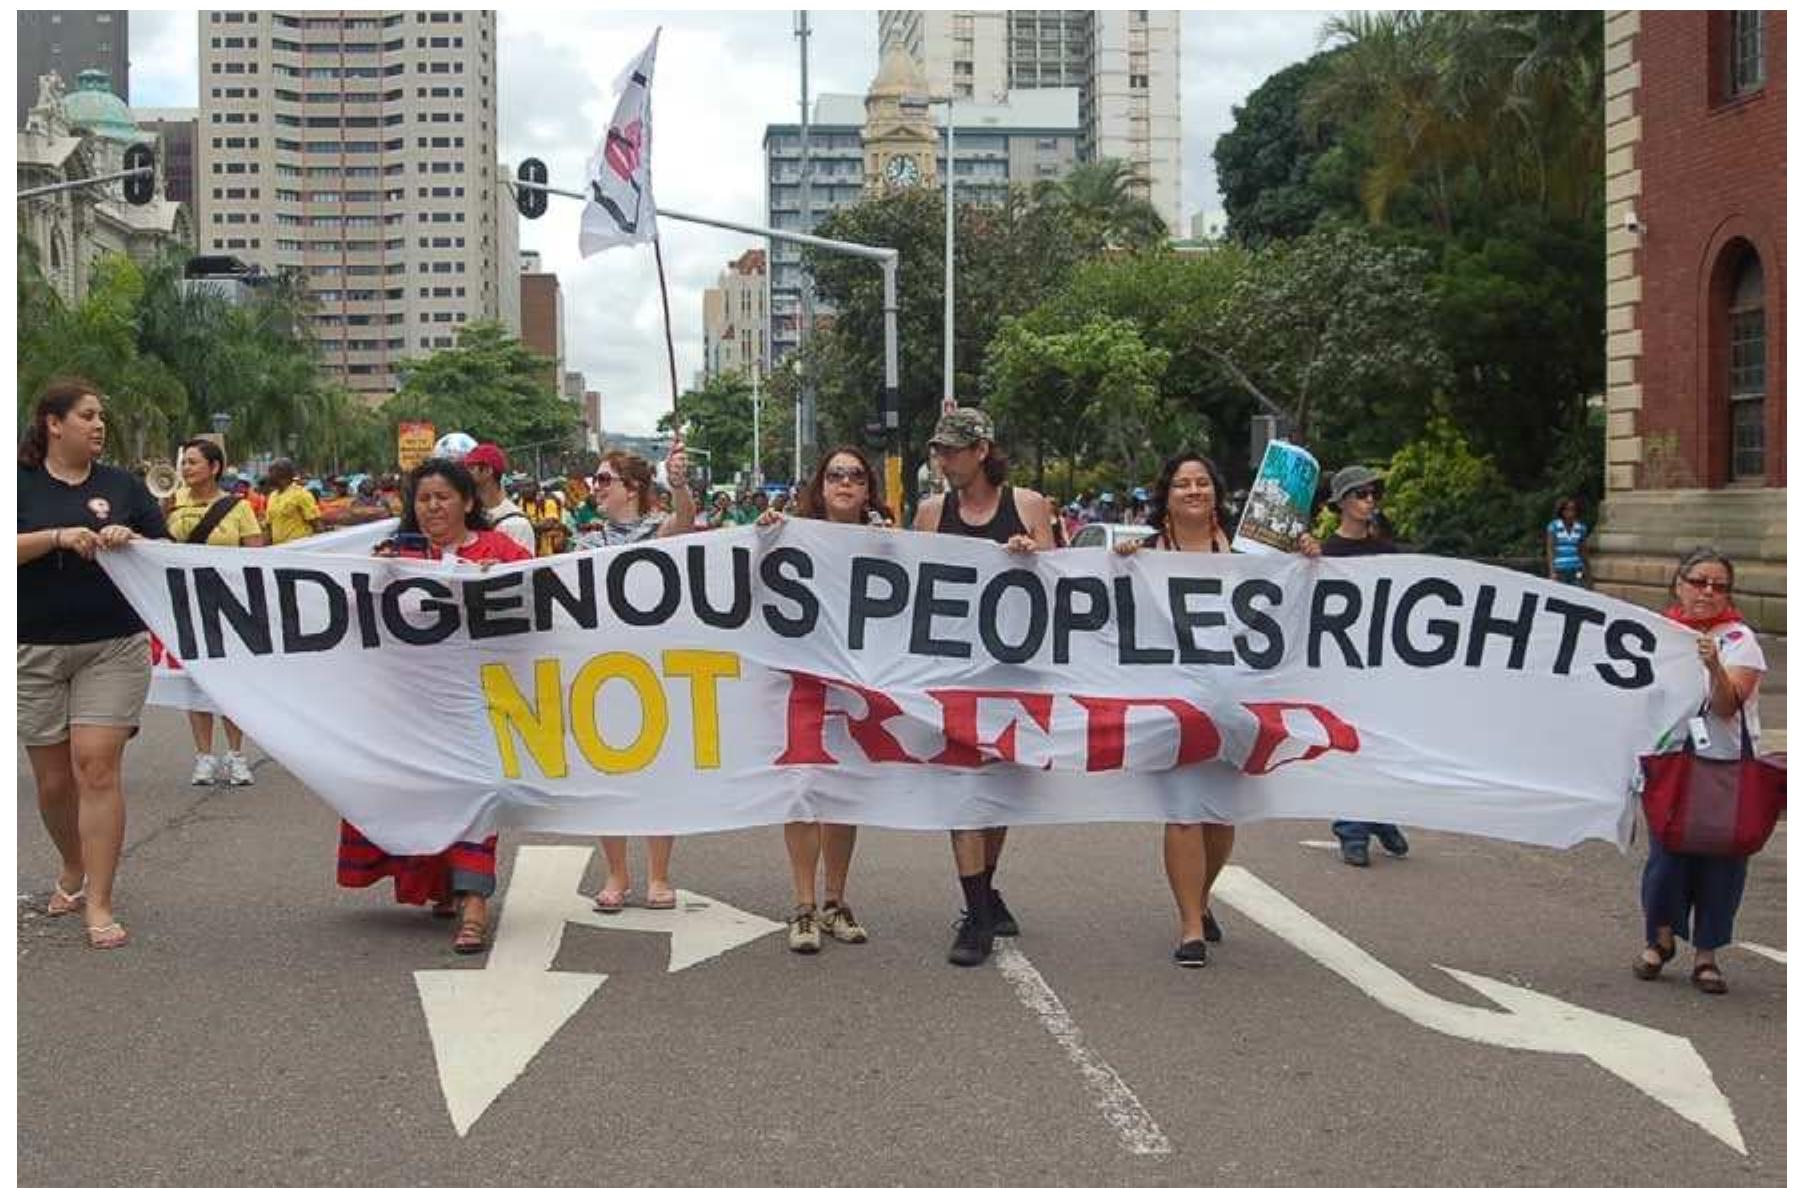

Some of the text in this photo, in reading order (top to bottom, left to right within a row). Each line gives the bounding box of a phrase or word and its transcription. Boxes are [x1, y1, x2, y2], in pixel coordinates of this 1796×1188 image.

[166, 546, 1657, 689] INDIGENOUS PEOPLES RIGHTS
[481, 650, 740, 779] NOT
